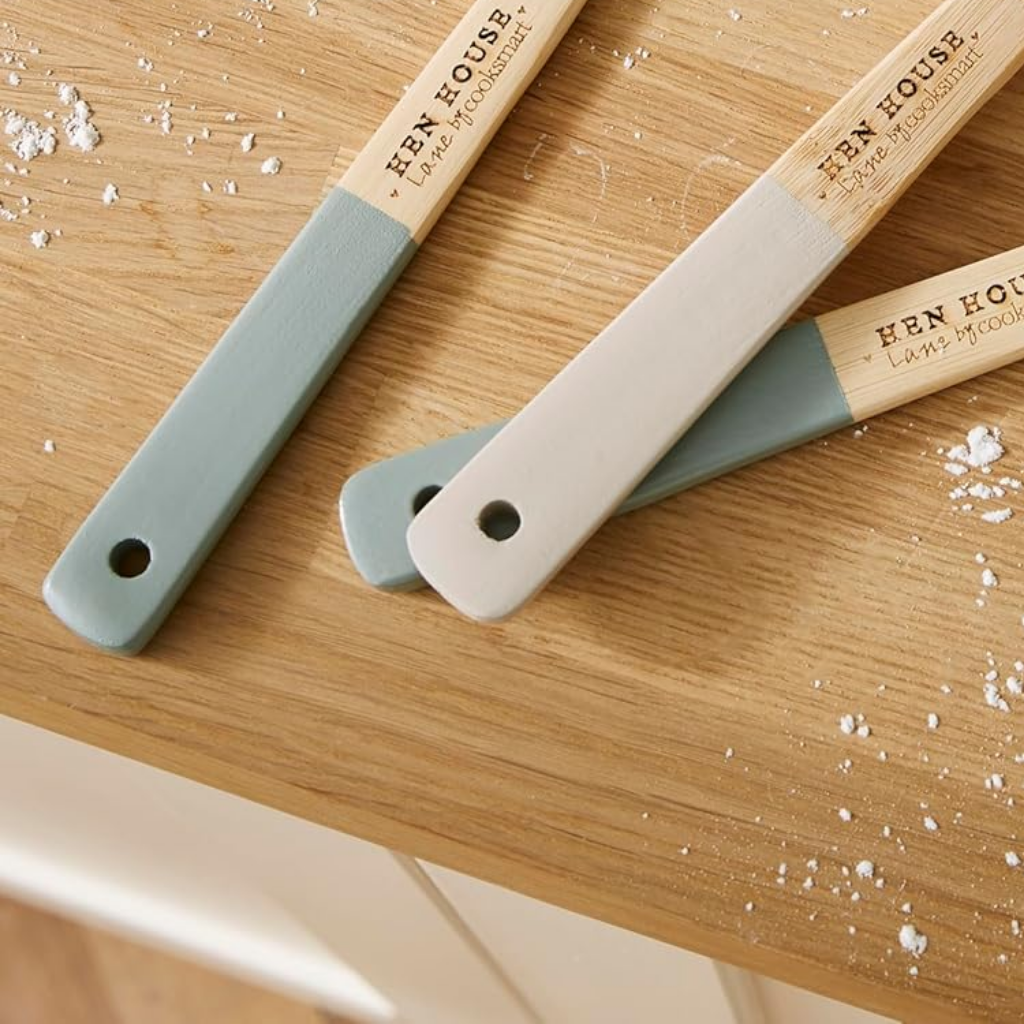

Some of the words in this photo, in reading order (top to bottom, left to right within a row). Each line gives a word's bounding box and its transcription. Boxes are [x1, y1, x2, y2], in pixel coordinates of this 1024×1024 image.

[385, 112, 439, 178] HEN
[434, 8, 512, 107] HOUSE
[817, 119, 877, 180] HEN
[876, 30, 965, 120] HOUSE
[406, 134, 454, 187] Lane
[837, 145, 889, 194] Lane
[875, 305, 949, 348] HEN
[887, 335, 951, 368] Lane
